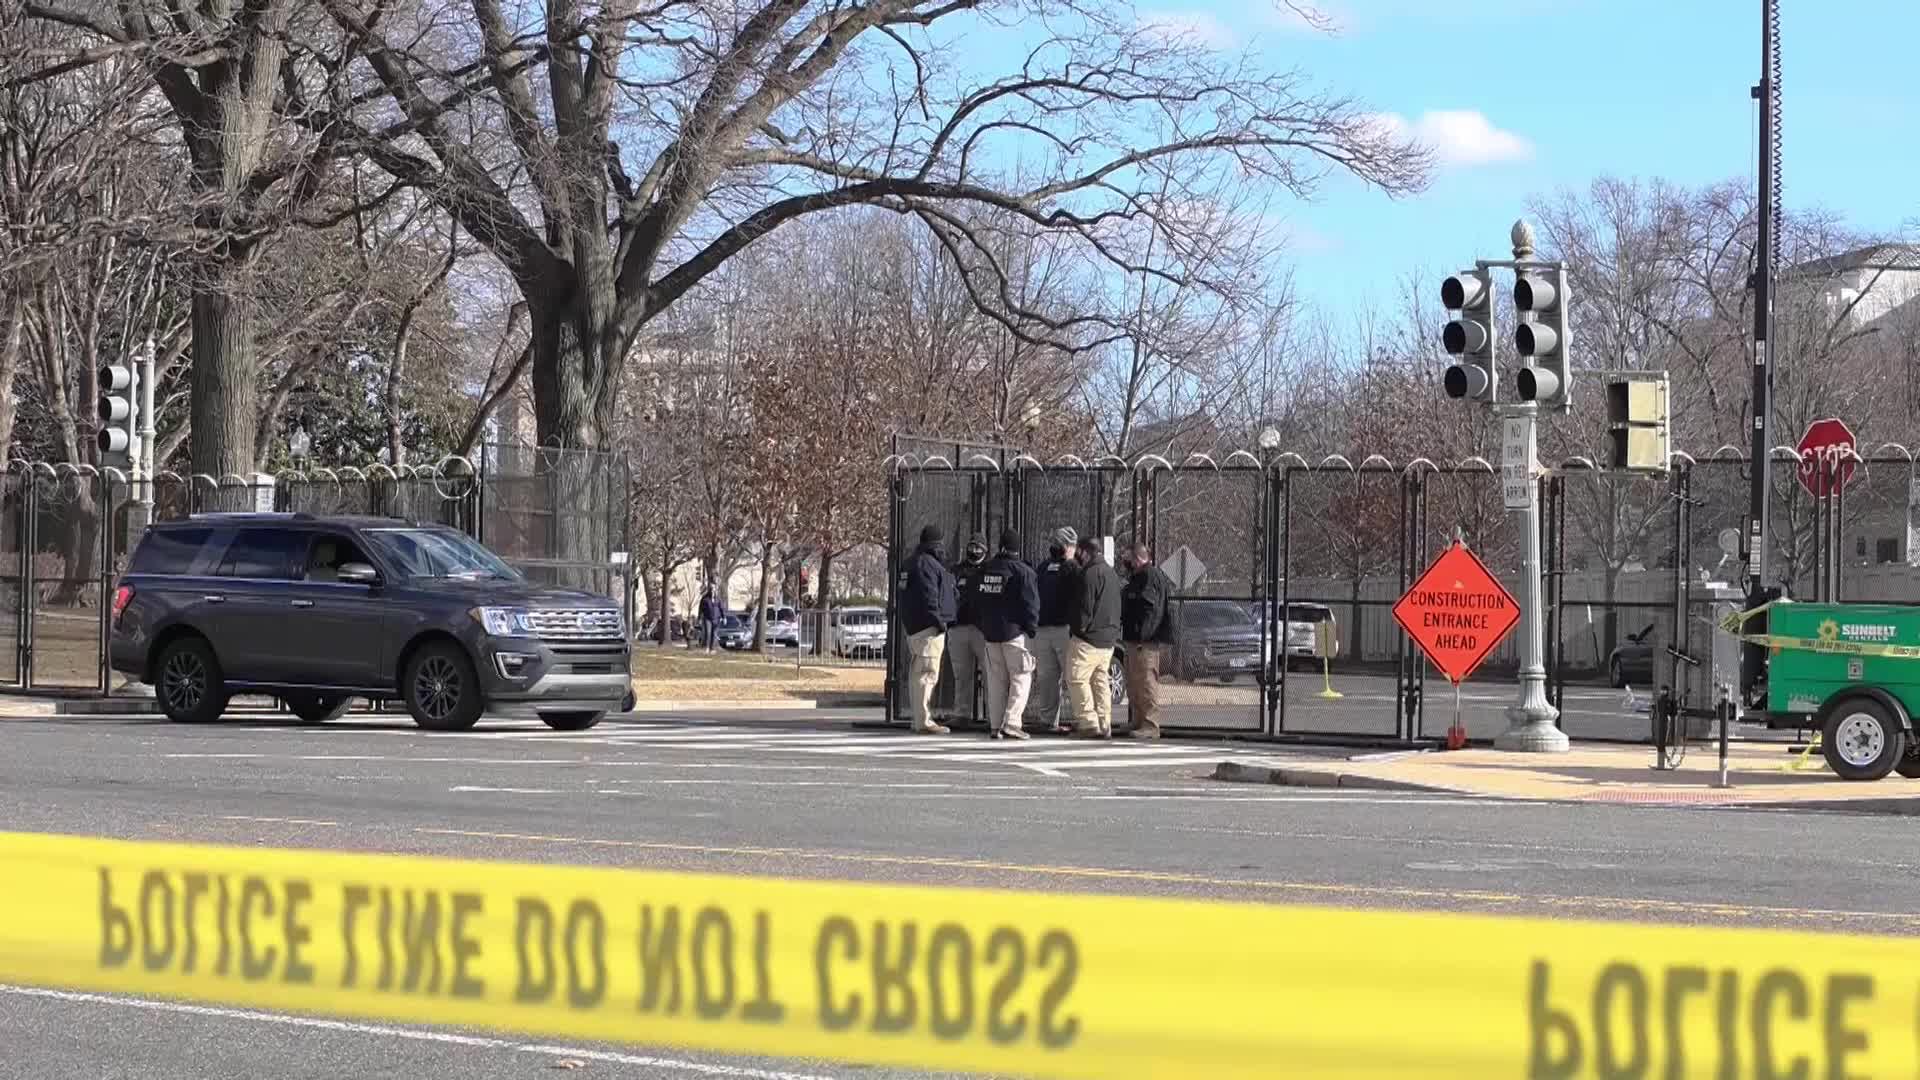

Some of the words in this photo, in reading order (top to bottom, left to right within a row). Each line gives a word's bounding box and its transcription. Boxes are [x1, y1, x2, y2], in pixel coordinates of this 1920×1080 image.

[1511, 424, 1521, 438] NO
[1802, 442, 1850, 475] STOP
[979, 583, 1002, 593] POLICE
[1410, 590, 1505, 609] CONSTRUCTION
[1423, 612, 1489, 629] ENTRANCE
[1841, 624, 1897, 637] SUNBELT
[1435, 634, 1477, 650] AHEAD
